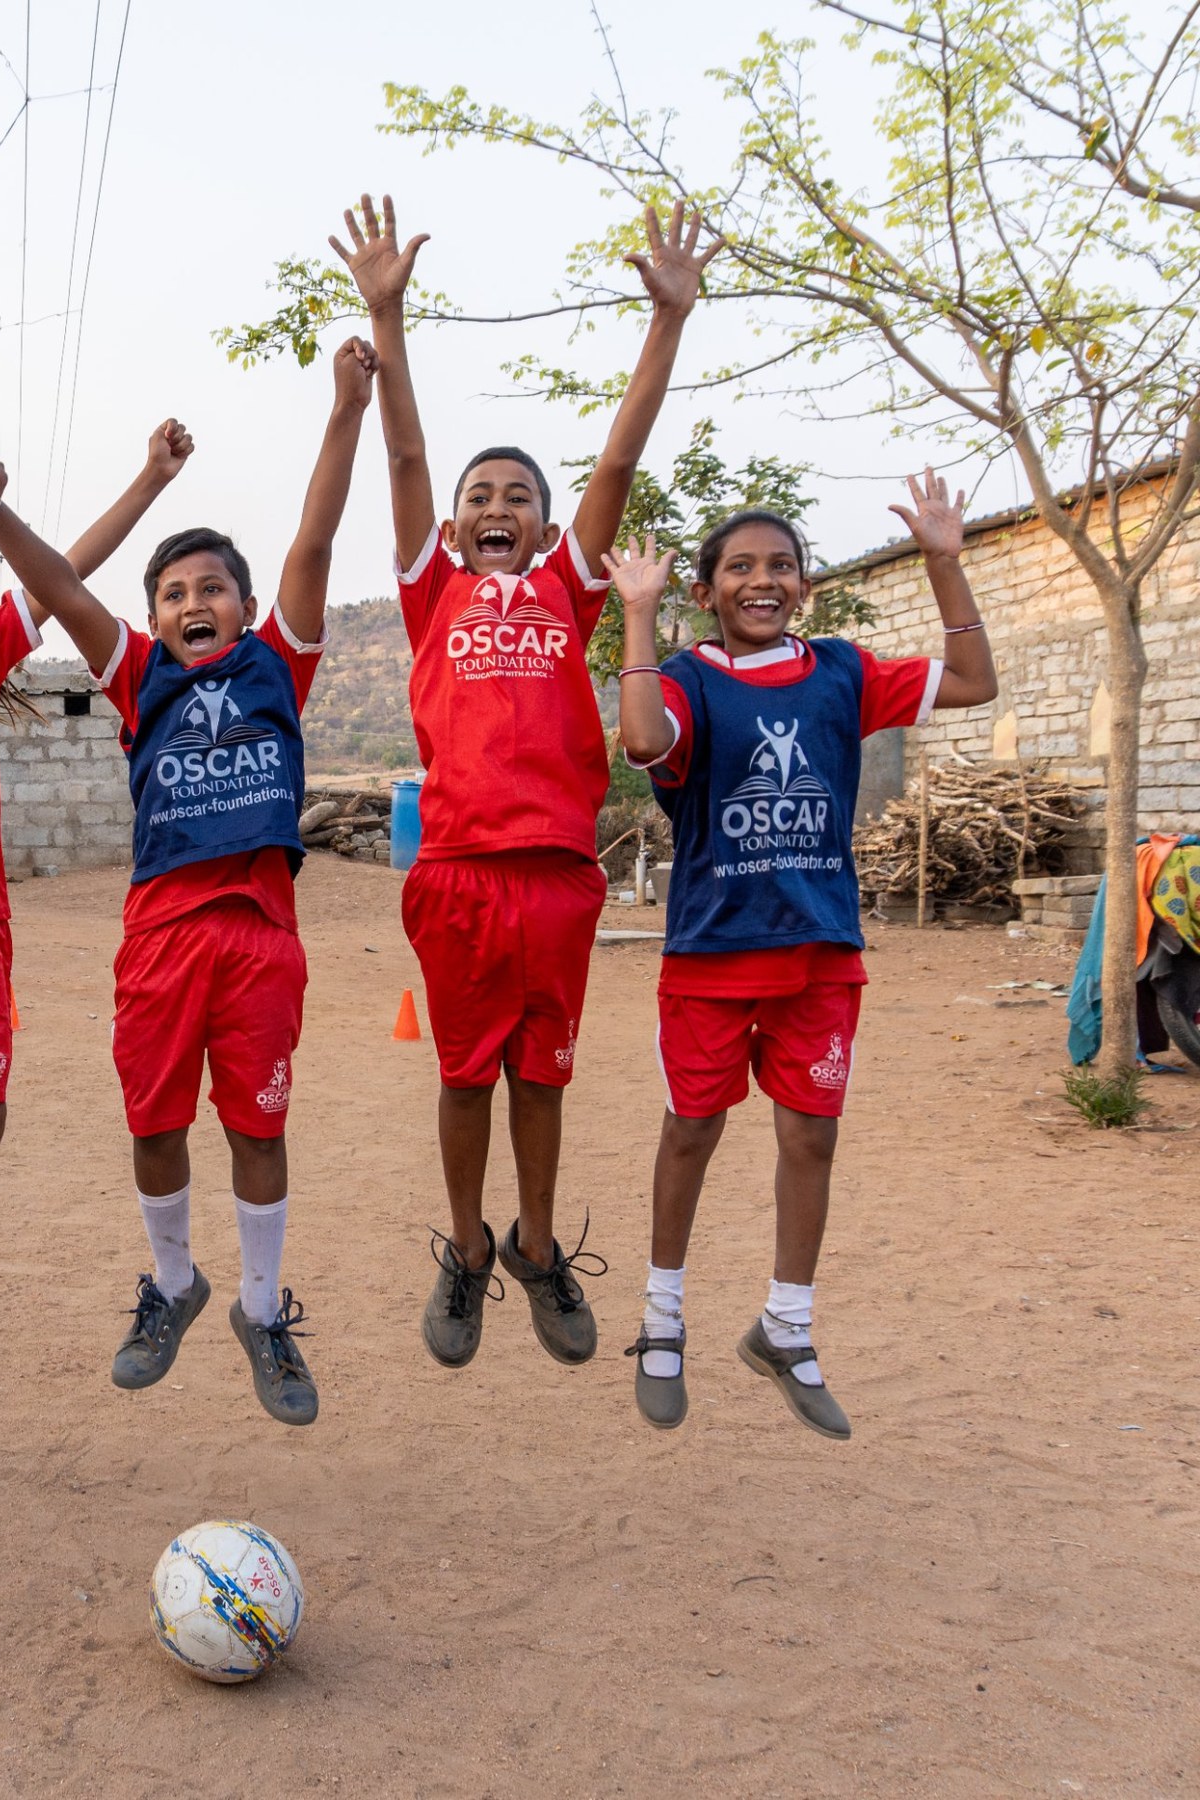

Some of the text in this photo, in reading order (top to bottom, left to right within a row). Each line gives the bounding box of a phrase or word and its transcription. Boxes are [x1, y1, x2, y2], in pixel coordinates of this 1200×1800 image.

[447, 624, 568, 659] OSCAR
[455, 654, 554, 673] FOUNDATION
[465, 670, 504, 680] EDUCATION
[531, 670, 548, 678] KICK
[156, 740, 281, 787] OSCAR
[170, 770, 275, 801] FOUNDATION
[721, 799, 828, 838] OSCAR
[739, 834, 820, 852] FOUNDATION
[258, 1556, 280, 1597] OSCAR
